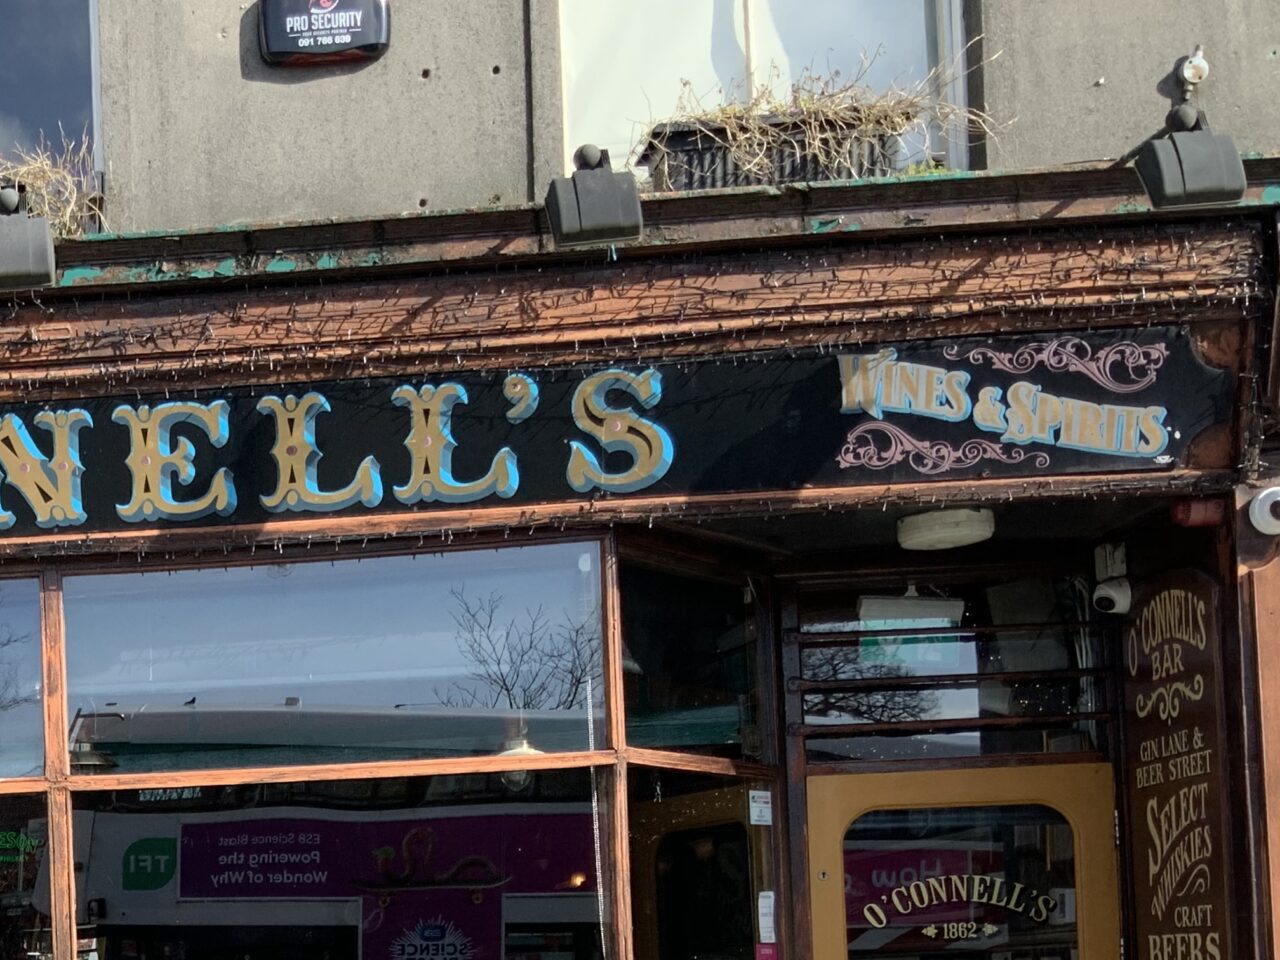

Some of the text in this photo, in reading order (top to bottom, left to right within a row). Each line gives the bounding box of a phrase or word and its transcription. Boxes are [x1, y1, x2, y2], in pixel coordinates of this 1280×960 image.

[286, 11, 362, 32] PRO SECURITY
[838, 348, 1169, 458] WINES & SPIRITS
[1128, 589, 1206, 677] O'CONNELL'S
[1151, 643, 1184, 681] BAR
[1140, 726, 1205, 762] GIN LANE &
[1136, 750, 1213, 789] BEER STREET
[1146, 782, 1209, 888] SELECT
[1151, 825, 1212, 922] WHISKIES
[863, 874, 1057, 929] O'CONNELL'S
[1174, 904, 1213, 928] CRAFT
[943, 922, 978, 940] 1862
